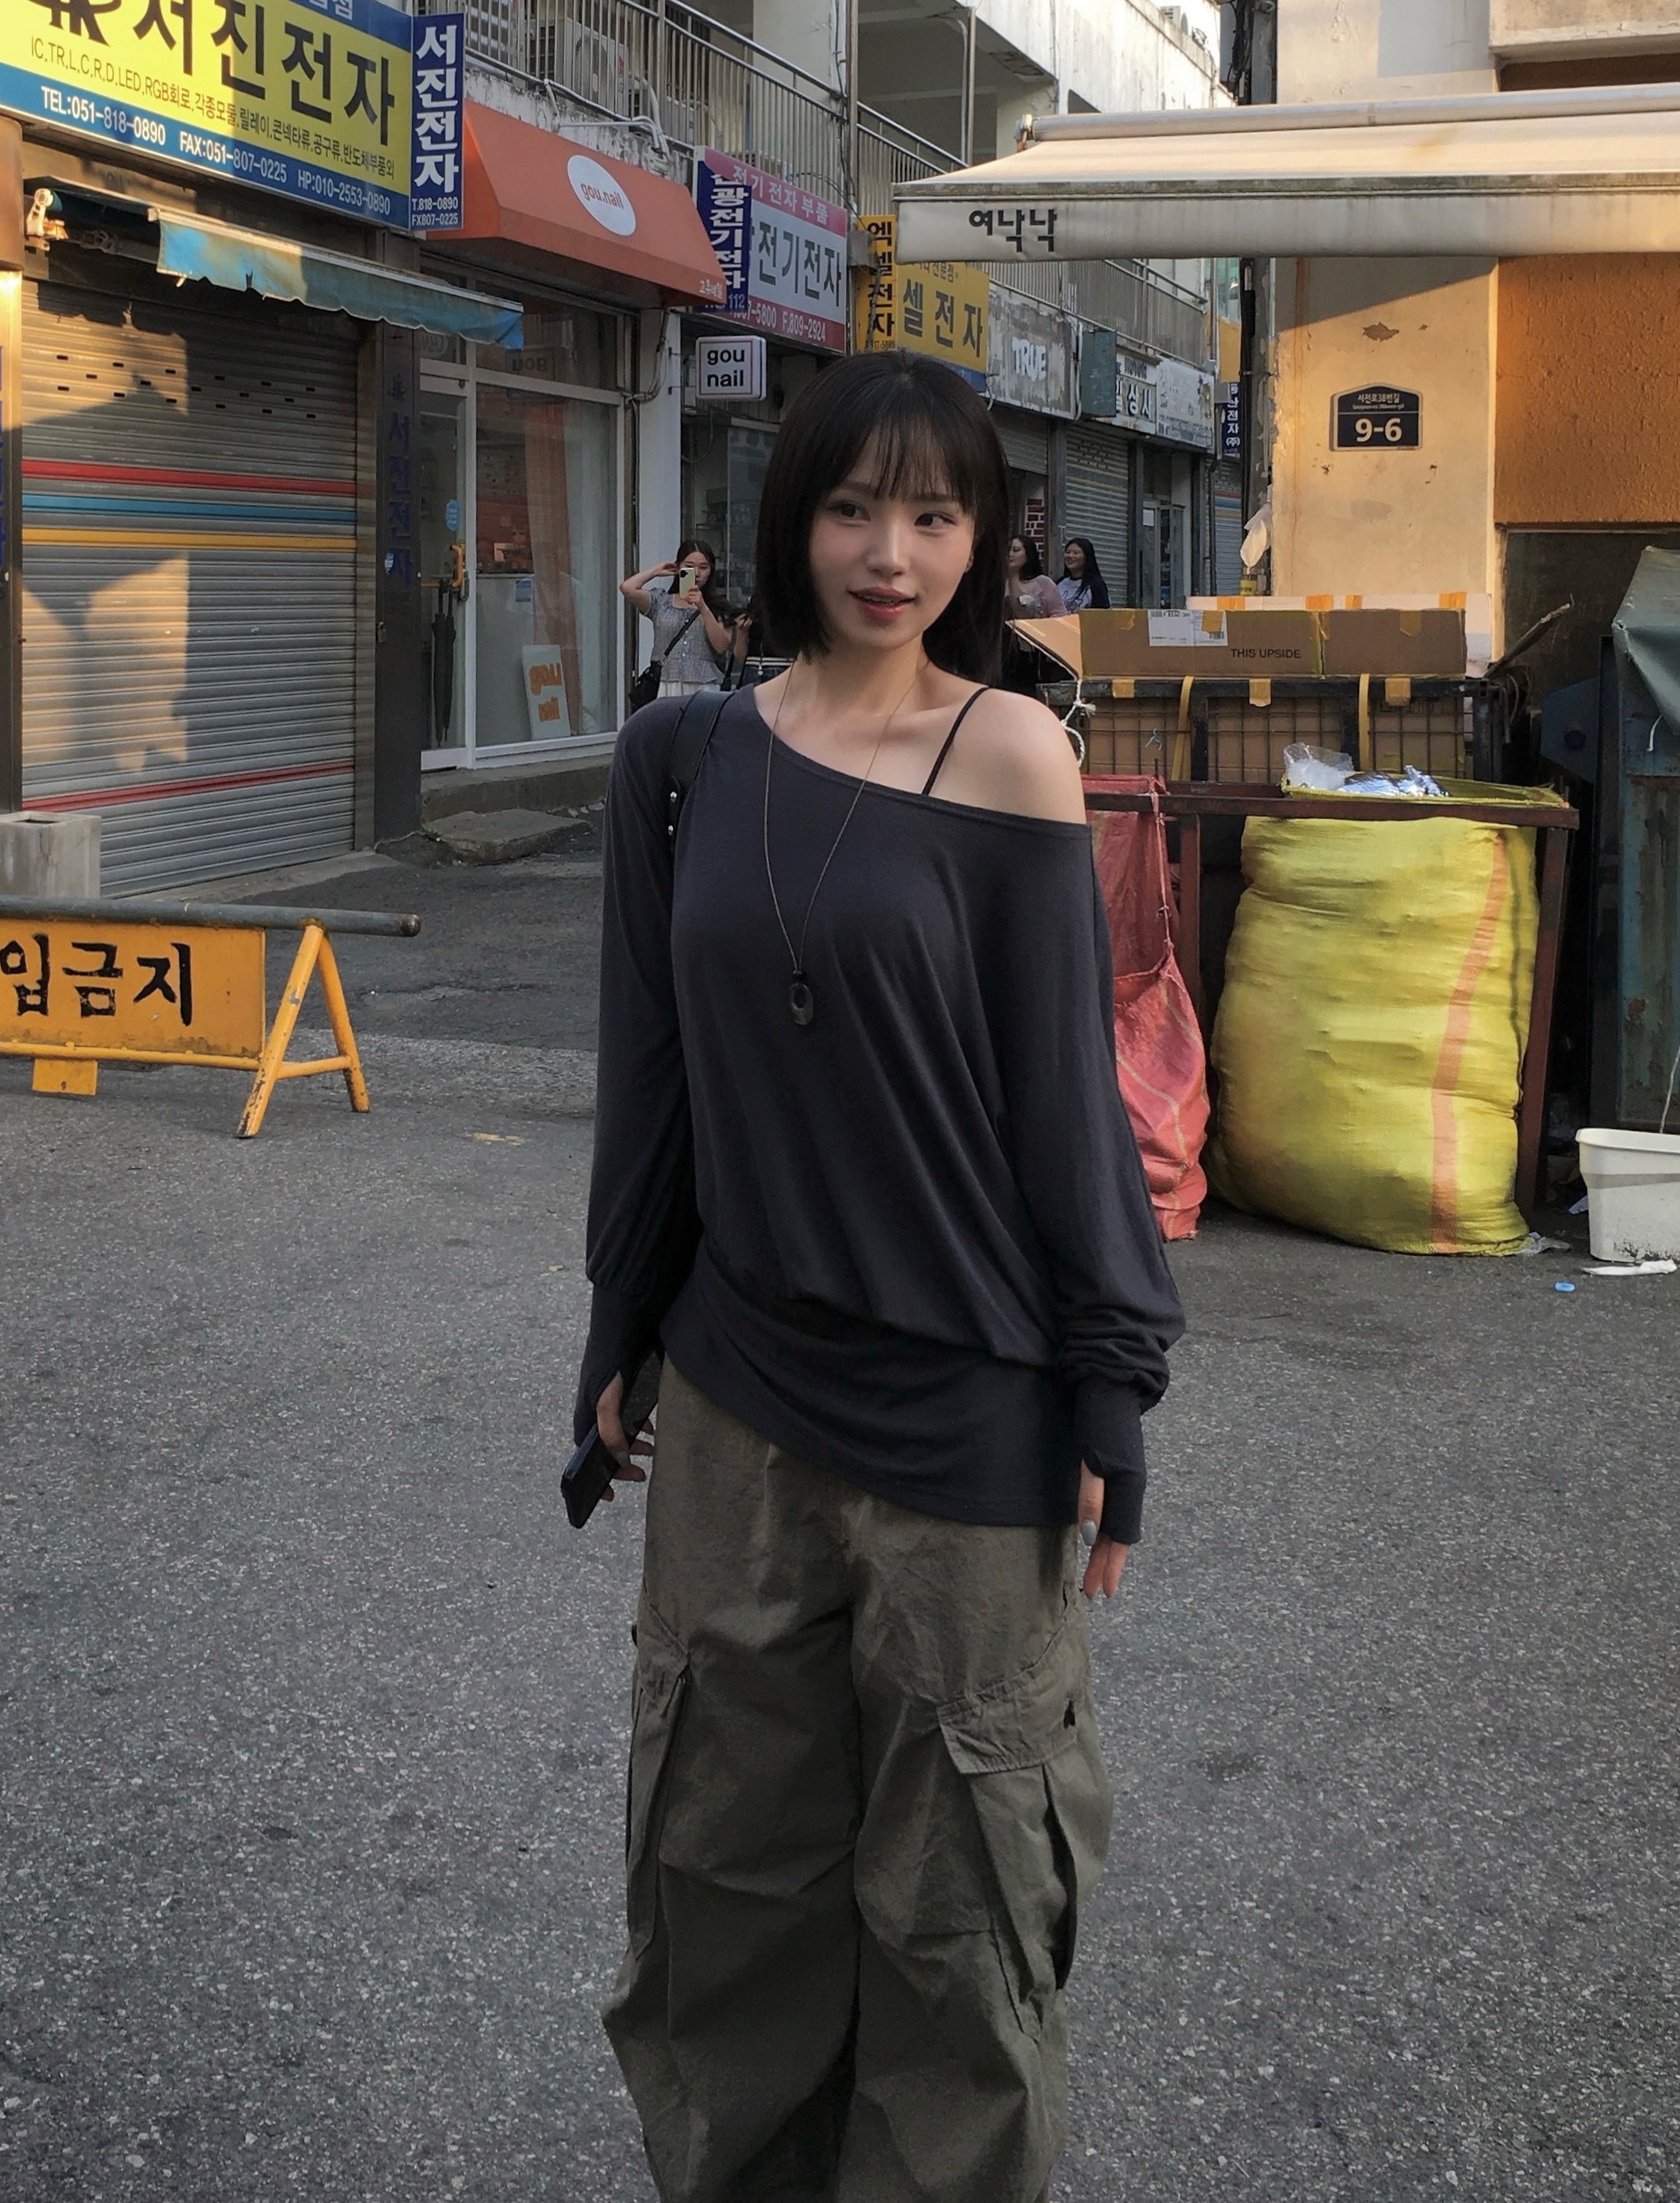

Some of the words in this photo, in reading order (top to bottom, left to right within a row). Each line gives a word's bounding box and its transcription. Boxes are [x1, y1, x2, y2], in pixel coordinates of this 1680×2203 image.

[414, 25, 459, 193] 서진전자
[41, 86, 166, 147] TEL:051-818-0890
[179, 131, 288, 183] FAX:051-807-0225
[580, 182, 625, 210] gou.nail
[769, 182, 797, 212] 전자
[802, 197, 828, 225] 부품
[969, 209, 1058, 253] 여낙낙
[707, 349, 745, 366] gou
[707, 370, 744, 388] nail
[1012, 337, 1047, 382] TRUE
[1355, 417, 1402, 442] 9-6
[1230, 648, 1256, 659] THIS
[1258, 648, 1302, 659] UPSIDE
[0, 933, 193, 1027] 입금지
